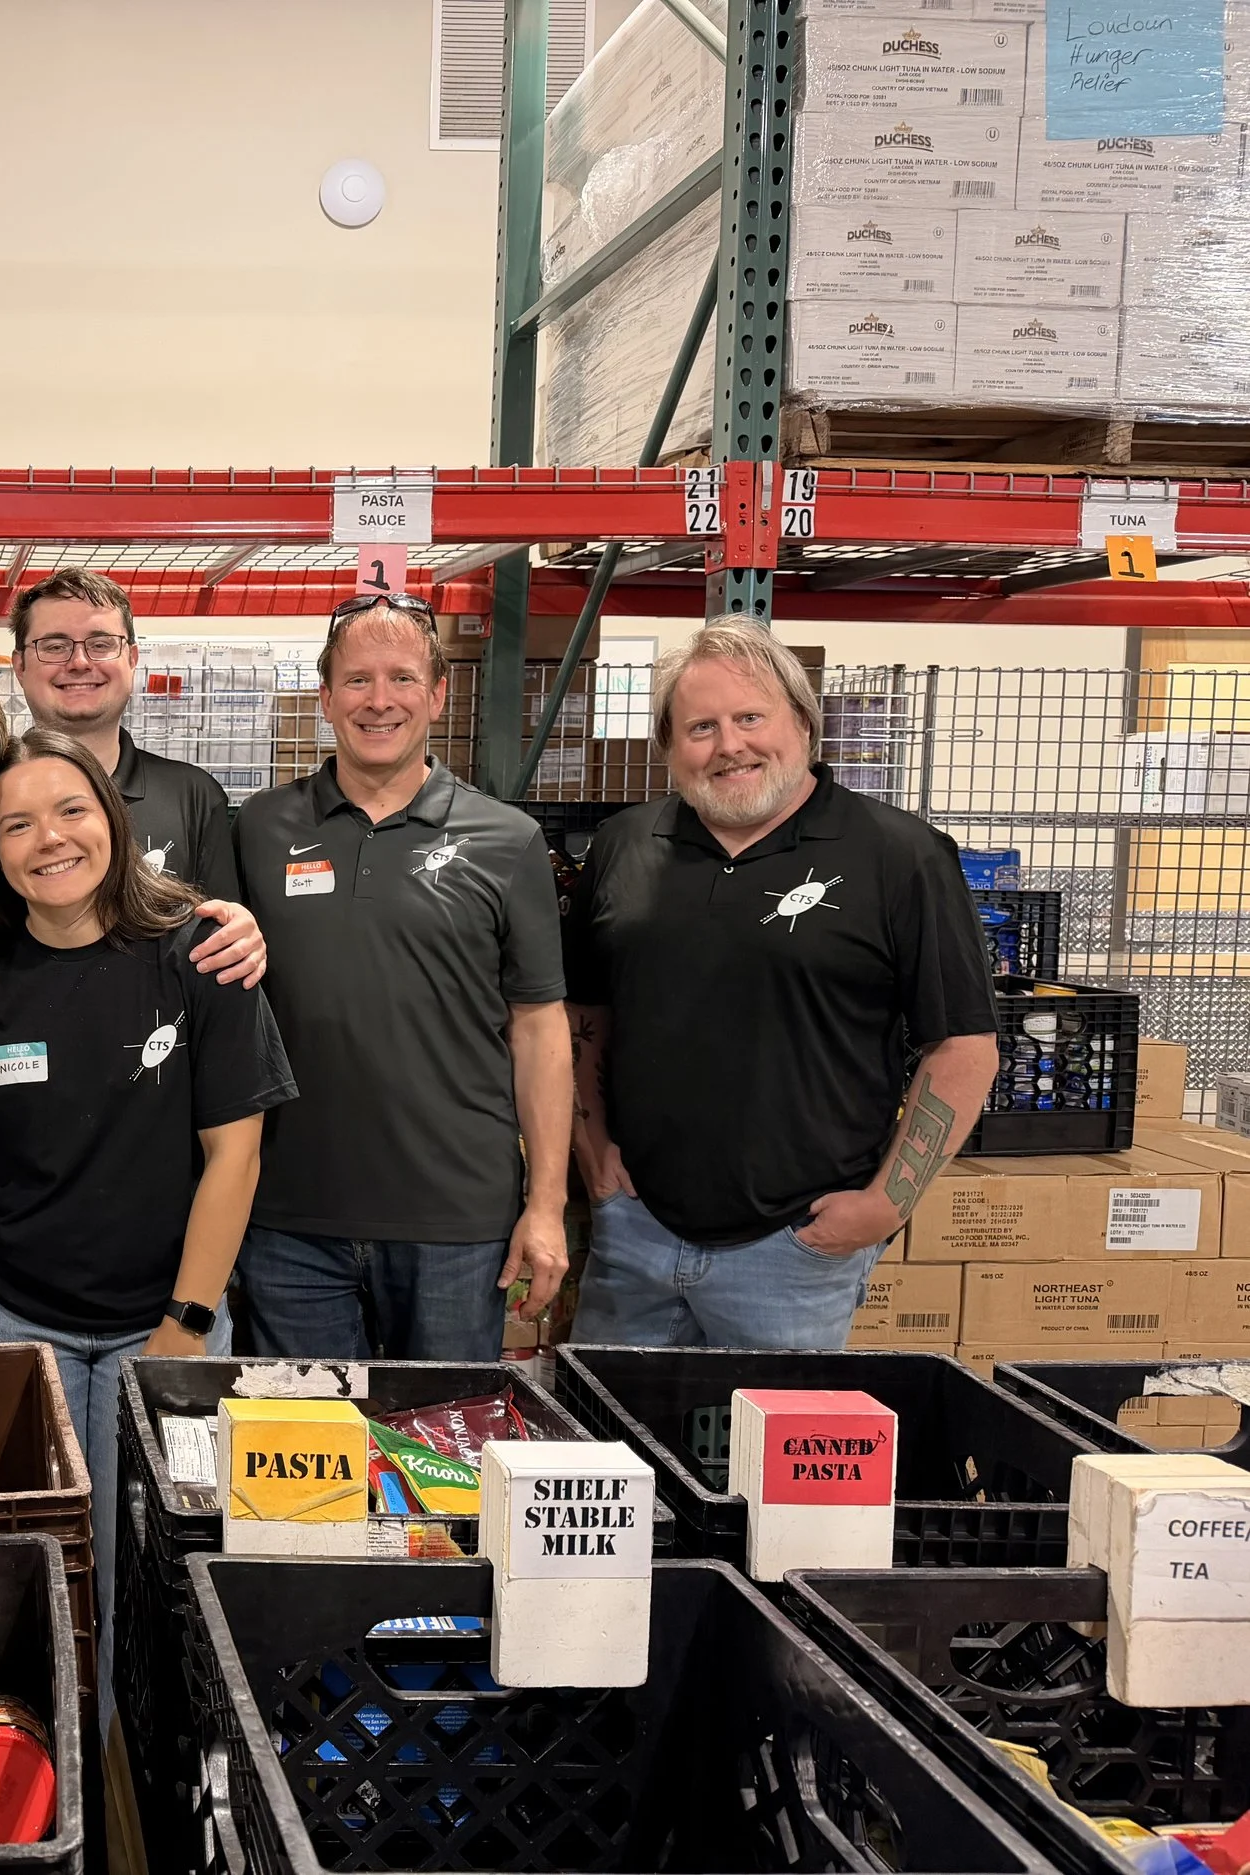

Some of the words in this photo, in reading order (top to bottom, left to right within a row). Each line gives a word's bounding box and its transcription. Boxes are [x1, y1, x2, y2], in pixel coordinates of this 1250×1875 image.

[882, 40, 939, 54] DUCHESS
[1070, 44, 1153, 74] Hunger
[1071, 72, 1131, 91] Relief
[874, 133, 932, 148] DUCHESS
[1097, 137, 1153, 152] DUCHESS
[871, 158, 892, 166] LIGHT
[847, 229, 892, 240] DUCHESS
[1015, 234, 1060, 246] DUCHESS
[1013, 328, 1057, 339] DUCHESS
[688, 470, 716, 499] 21
[790, 472, 815, 500] 19
[362, 495, 404, 506] PASTA
[358, 515, 406, 526] SAUCE
[688, 504, 717, 532] 22
[785, 508, 811, 536] 20
[1110, 515, 1146, 526] TUNA
[1118, 551, 1145, 578] 1
[433, 852, 450, 862] CTS
[292, 879, 313, 888] Scott
[790, 893, 814, 905] CTS
[7, 1045, 30, 1054] HELLO
[148, 1041, 170, 1051] CTS
[0, 1060, 40, 1074] NICOLE
[1033, 1284, 1104, 1293] NORTHEAST
[782, 1438, 876, 1458] CANNED
[245, 1451, 355, 1482] PASTA
[400, 1454, 474, 1485] Knorr
[791, 1463, 864, 1482] PASTA
[533, 1478, 629, 1502] SHELF
[523, 1506, 636, 1529] STABLE
[541, 1533, 618, 1557] MILK
[1169, 1561, 1210, 1581] TEA
